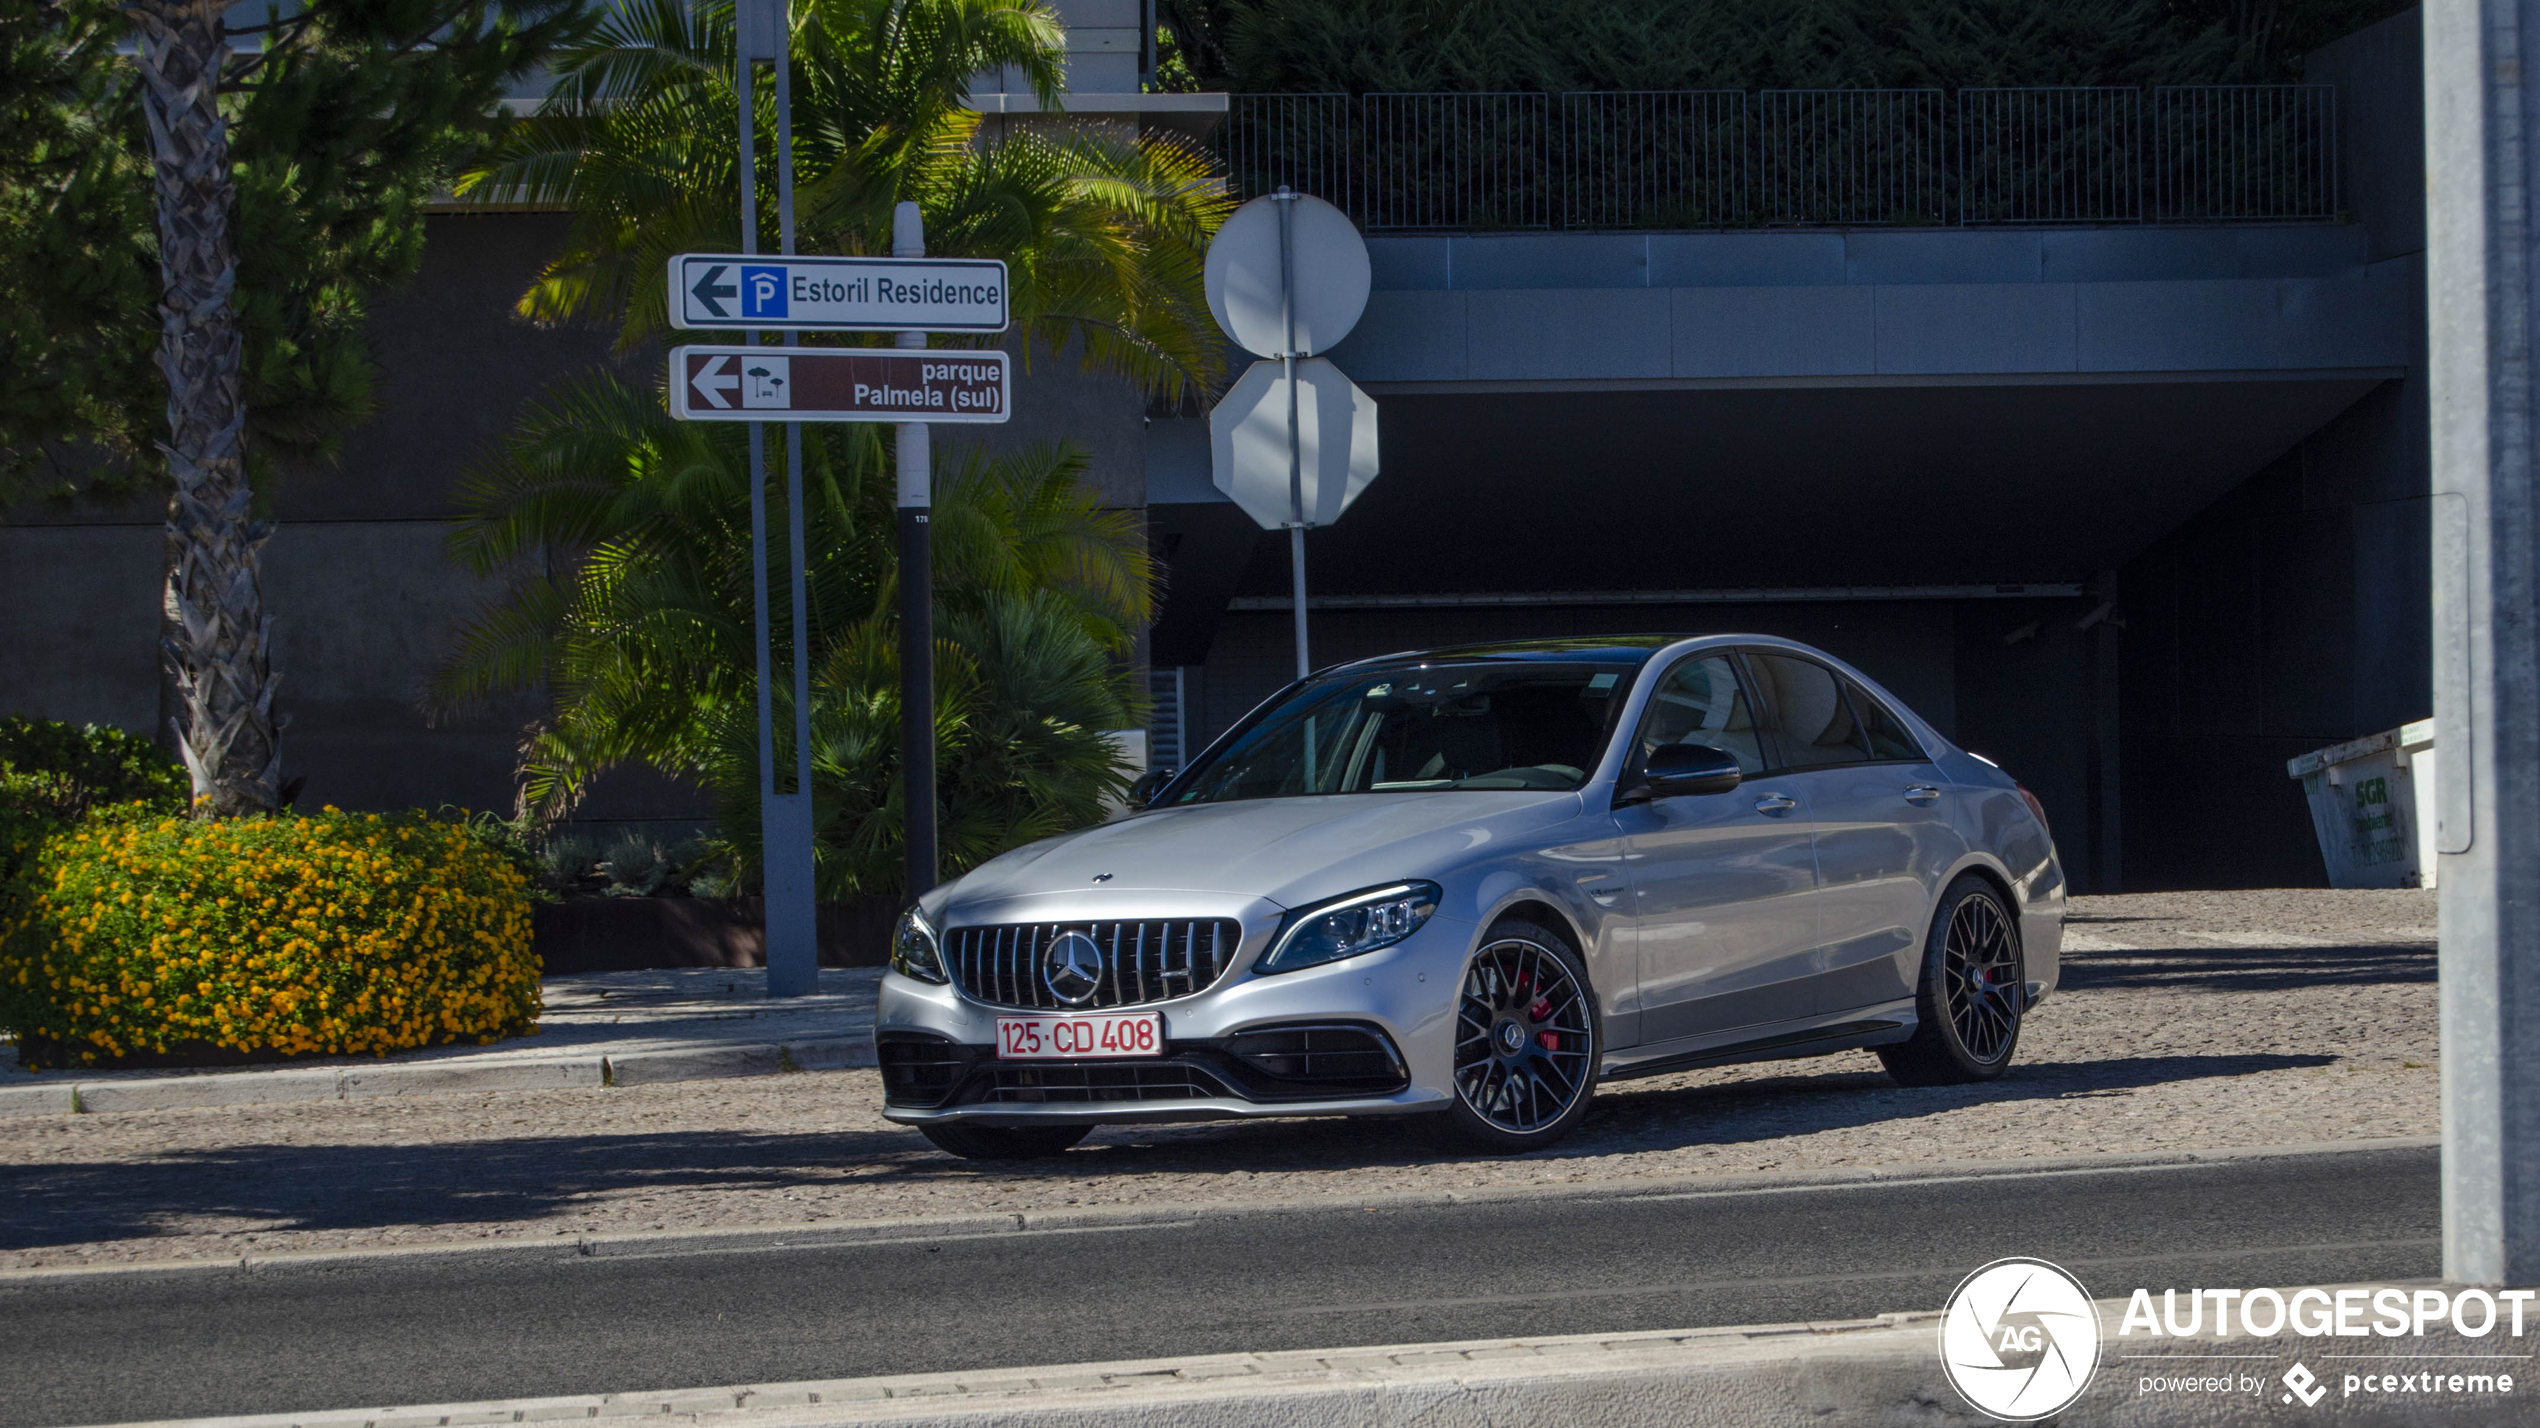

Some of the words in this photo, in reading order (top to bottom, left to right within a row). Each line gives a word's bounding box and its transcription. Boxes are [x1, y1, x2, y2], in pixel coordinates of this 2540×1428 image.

[756, 280, 776, 313] P
[792, 276, 869, 303] Estoril
[877, 277, 999, 305] Residence
[922, 364, 1000, 386] parque
[854, 383, 944, 407] Palmela
[950, 385, 1000, 413] (sul)
[2355, 776, 2388, 809] SGR
[1100, 1019, 1154, 1052] 408
